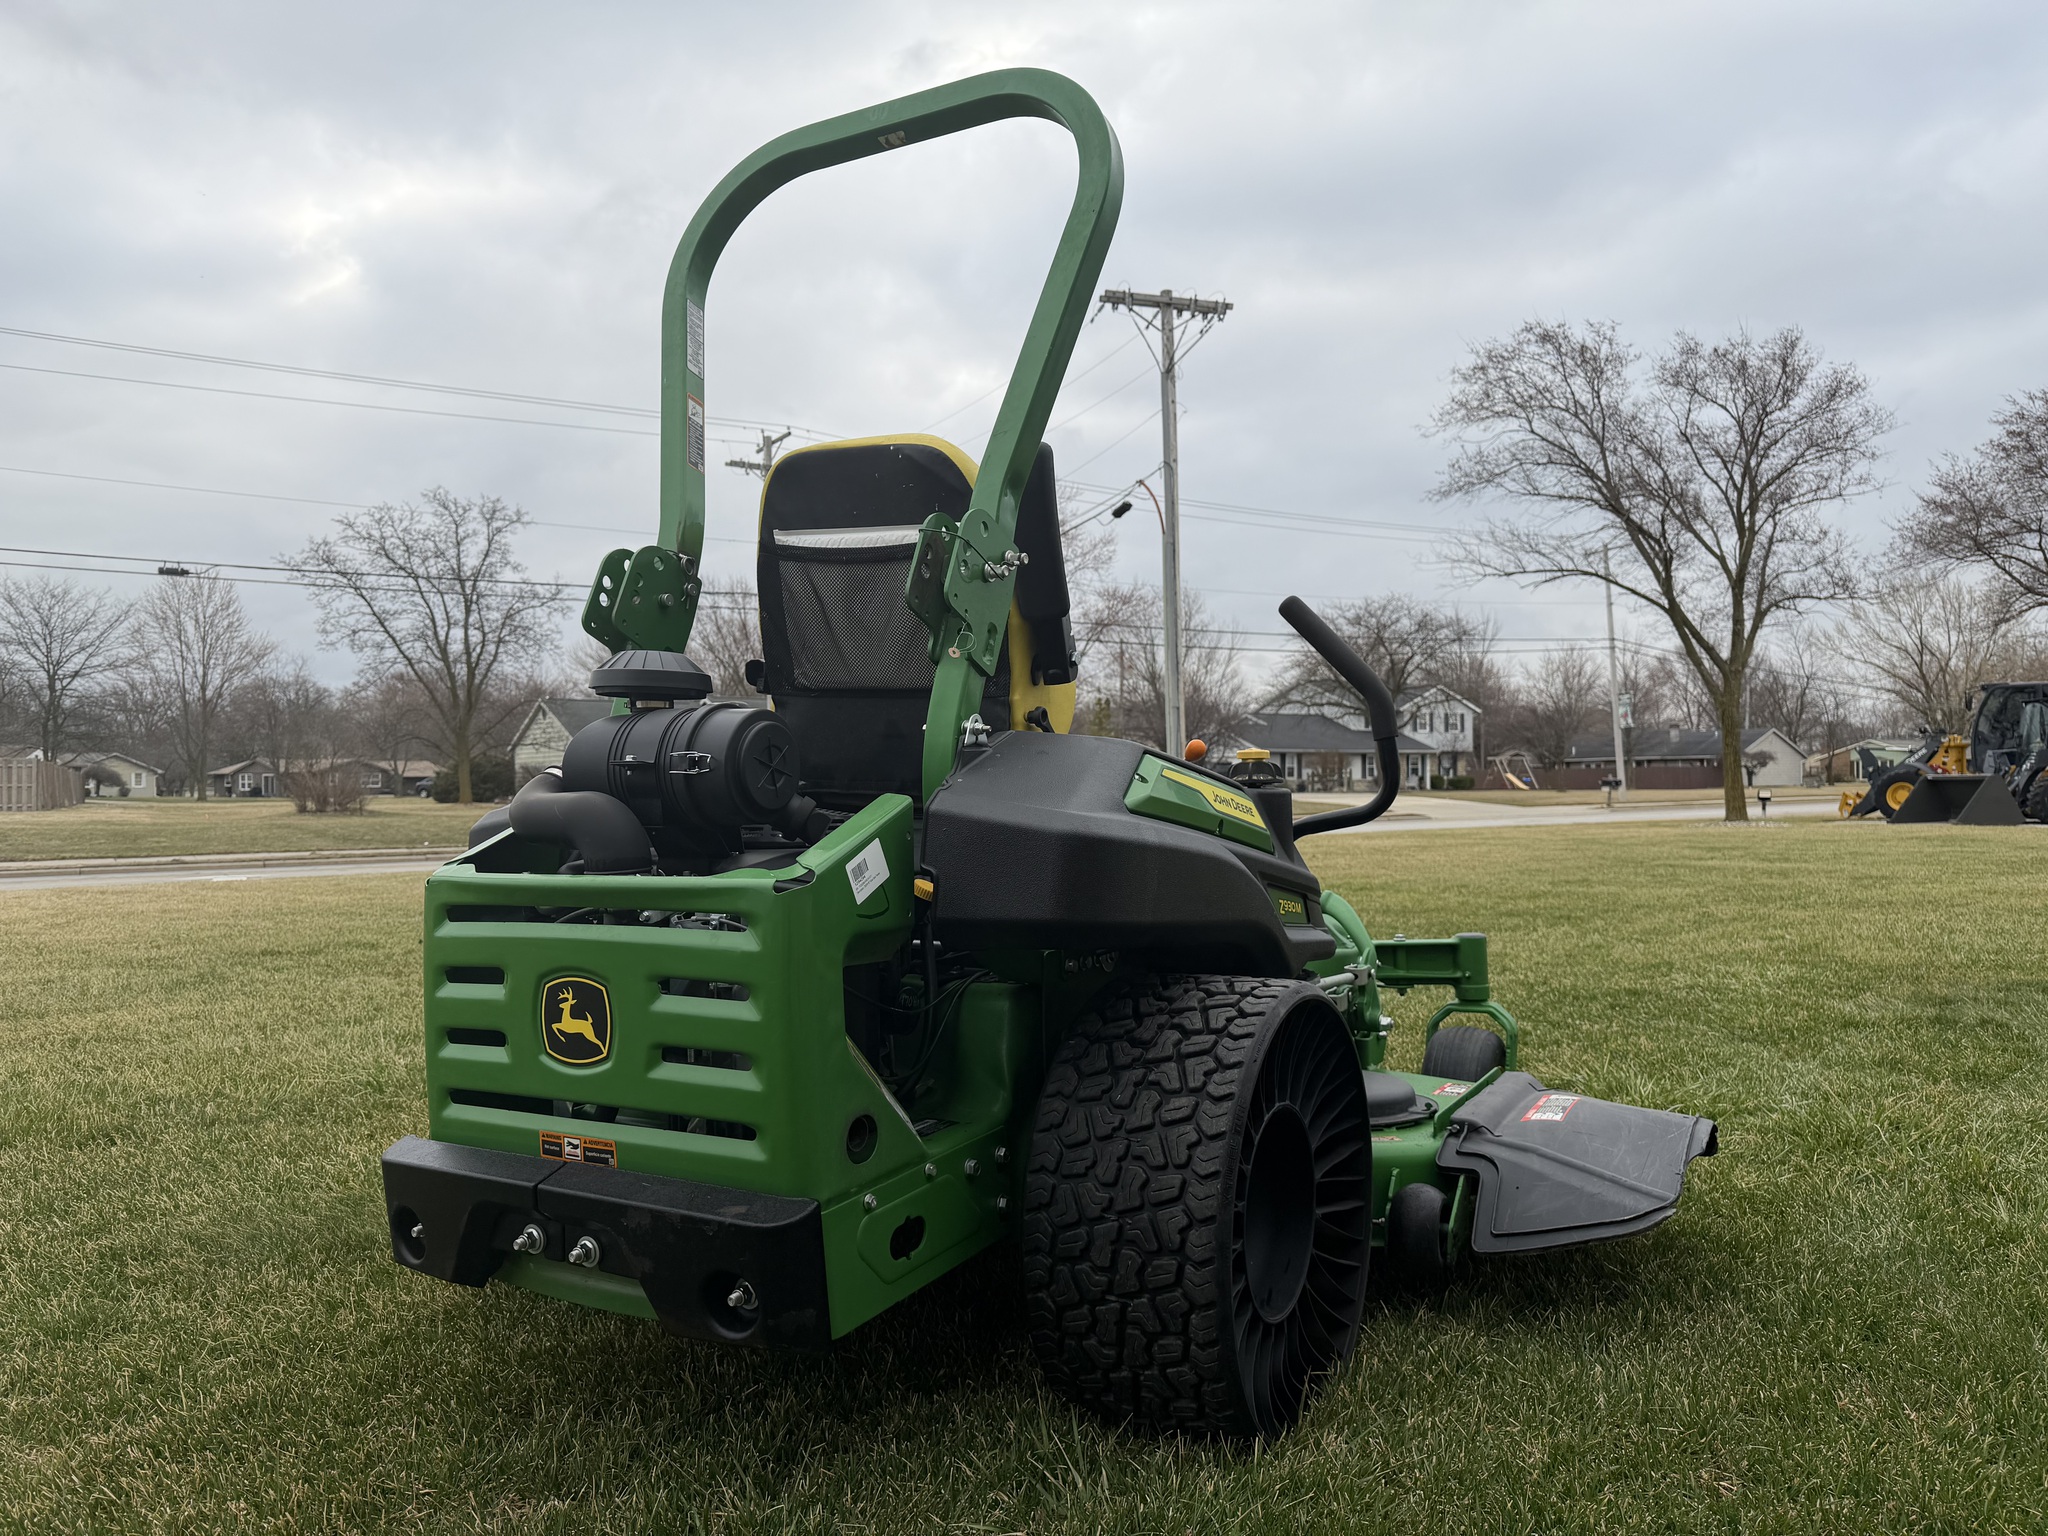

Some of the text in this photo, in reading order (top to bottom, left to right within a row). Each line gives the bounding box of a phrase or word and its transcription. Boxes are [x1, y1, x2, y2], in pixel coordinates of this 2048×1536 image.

[1212, 790, 1255, 817] JOHN DEERE
[1279, 899, 1302, 914] Z930M
